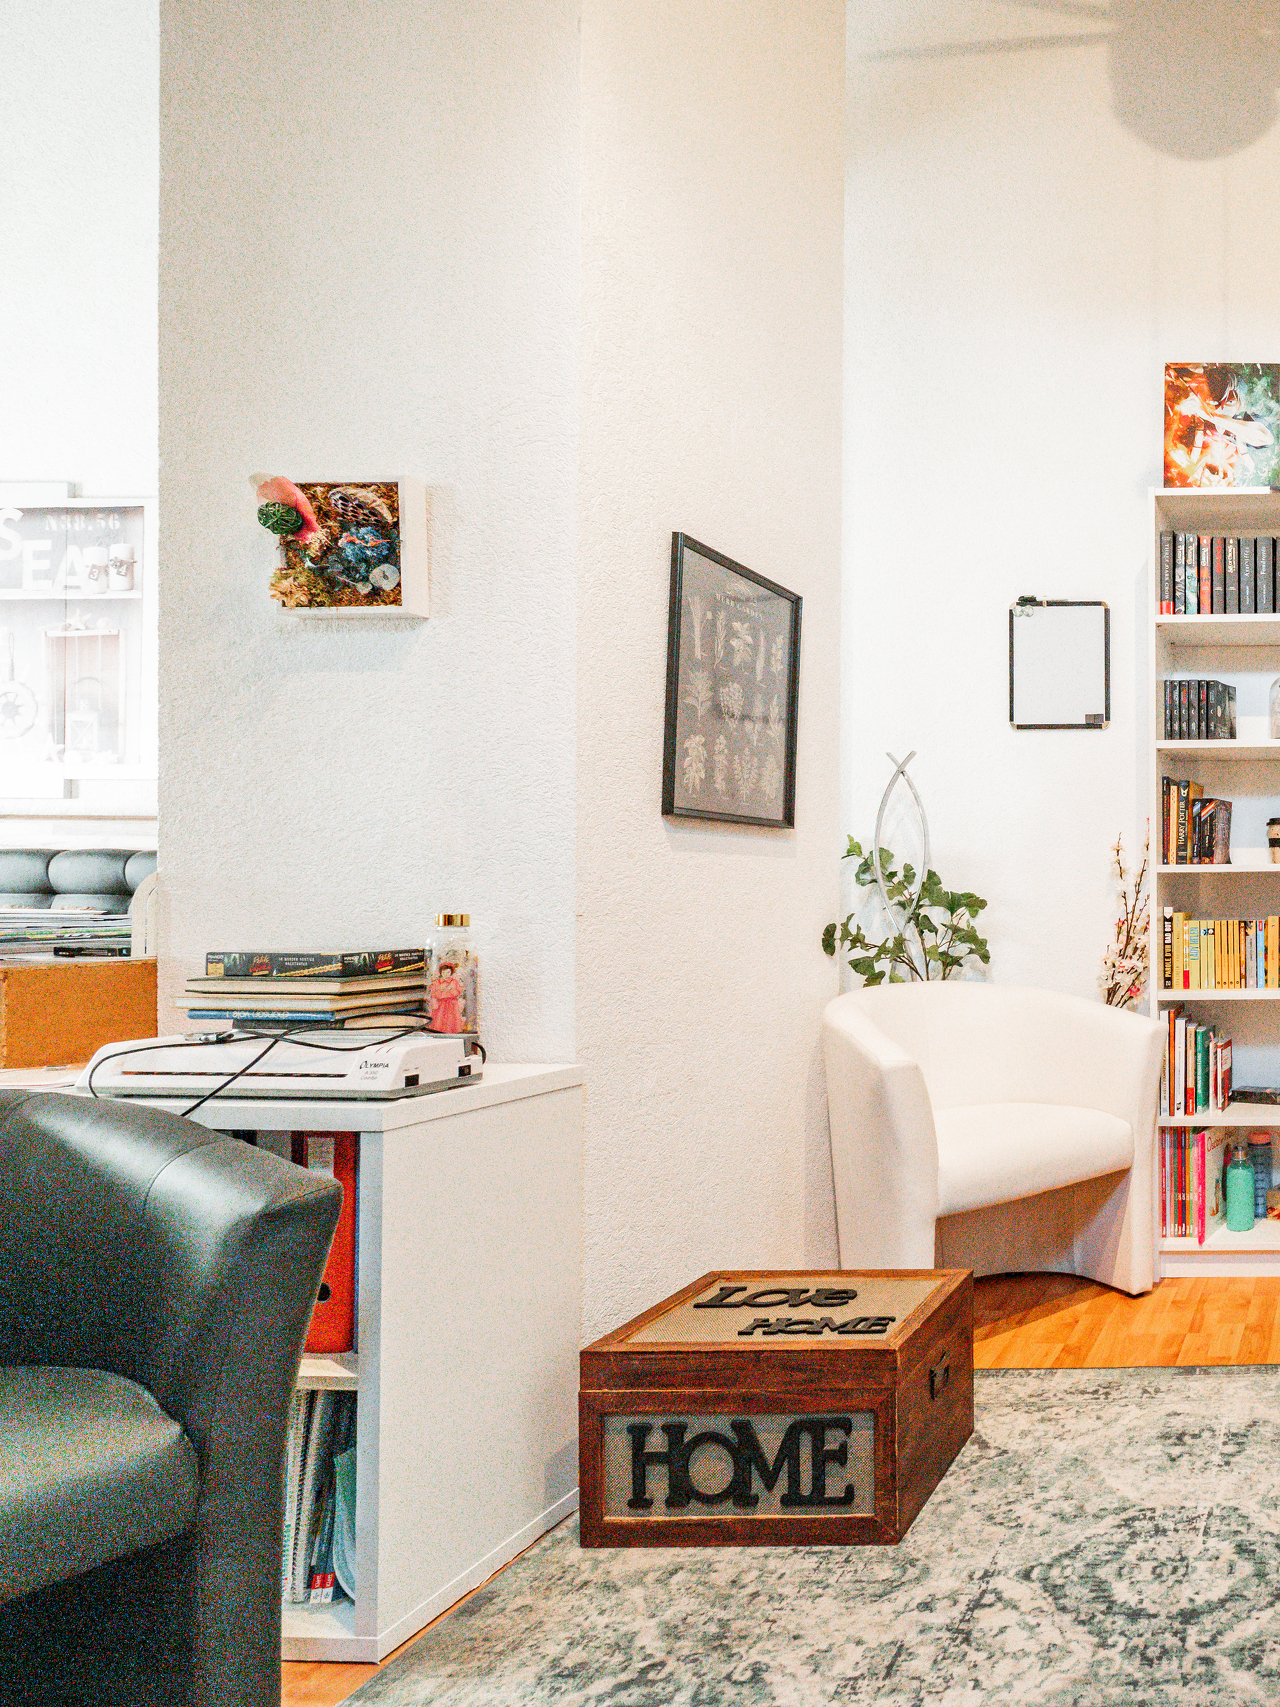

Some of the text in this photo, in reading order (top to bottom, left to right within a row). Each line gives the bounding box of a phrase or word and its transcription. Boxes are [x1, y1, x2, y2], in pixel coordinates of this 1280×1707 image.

[89, 568, 99, 580] 3
[118, 564, 127, 576] 4
[1177, 800, 1185, 822] POTTER
[1189, 926, 1199, 961] LADY HELEN
[358, 1059, 389, 1070] OLYMPIA
[737, 1315, 896, 1336] HOME
[626, 1416, 856, 1510] HOME
